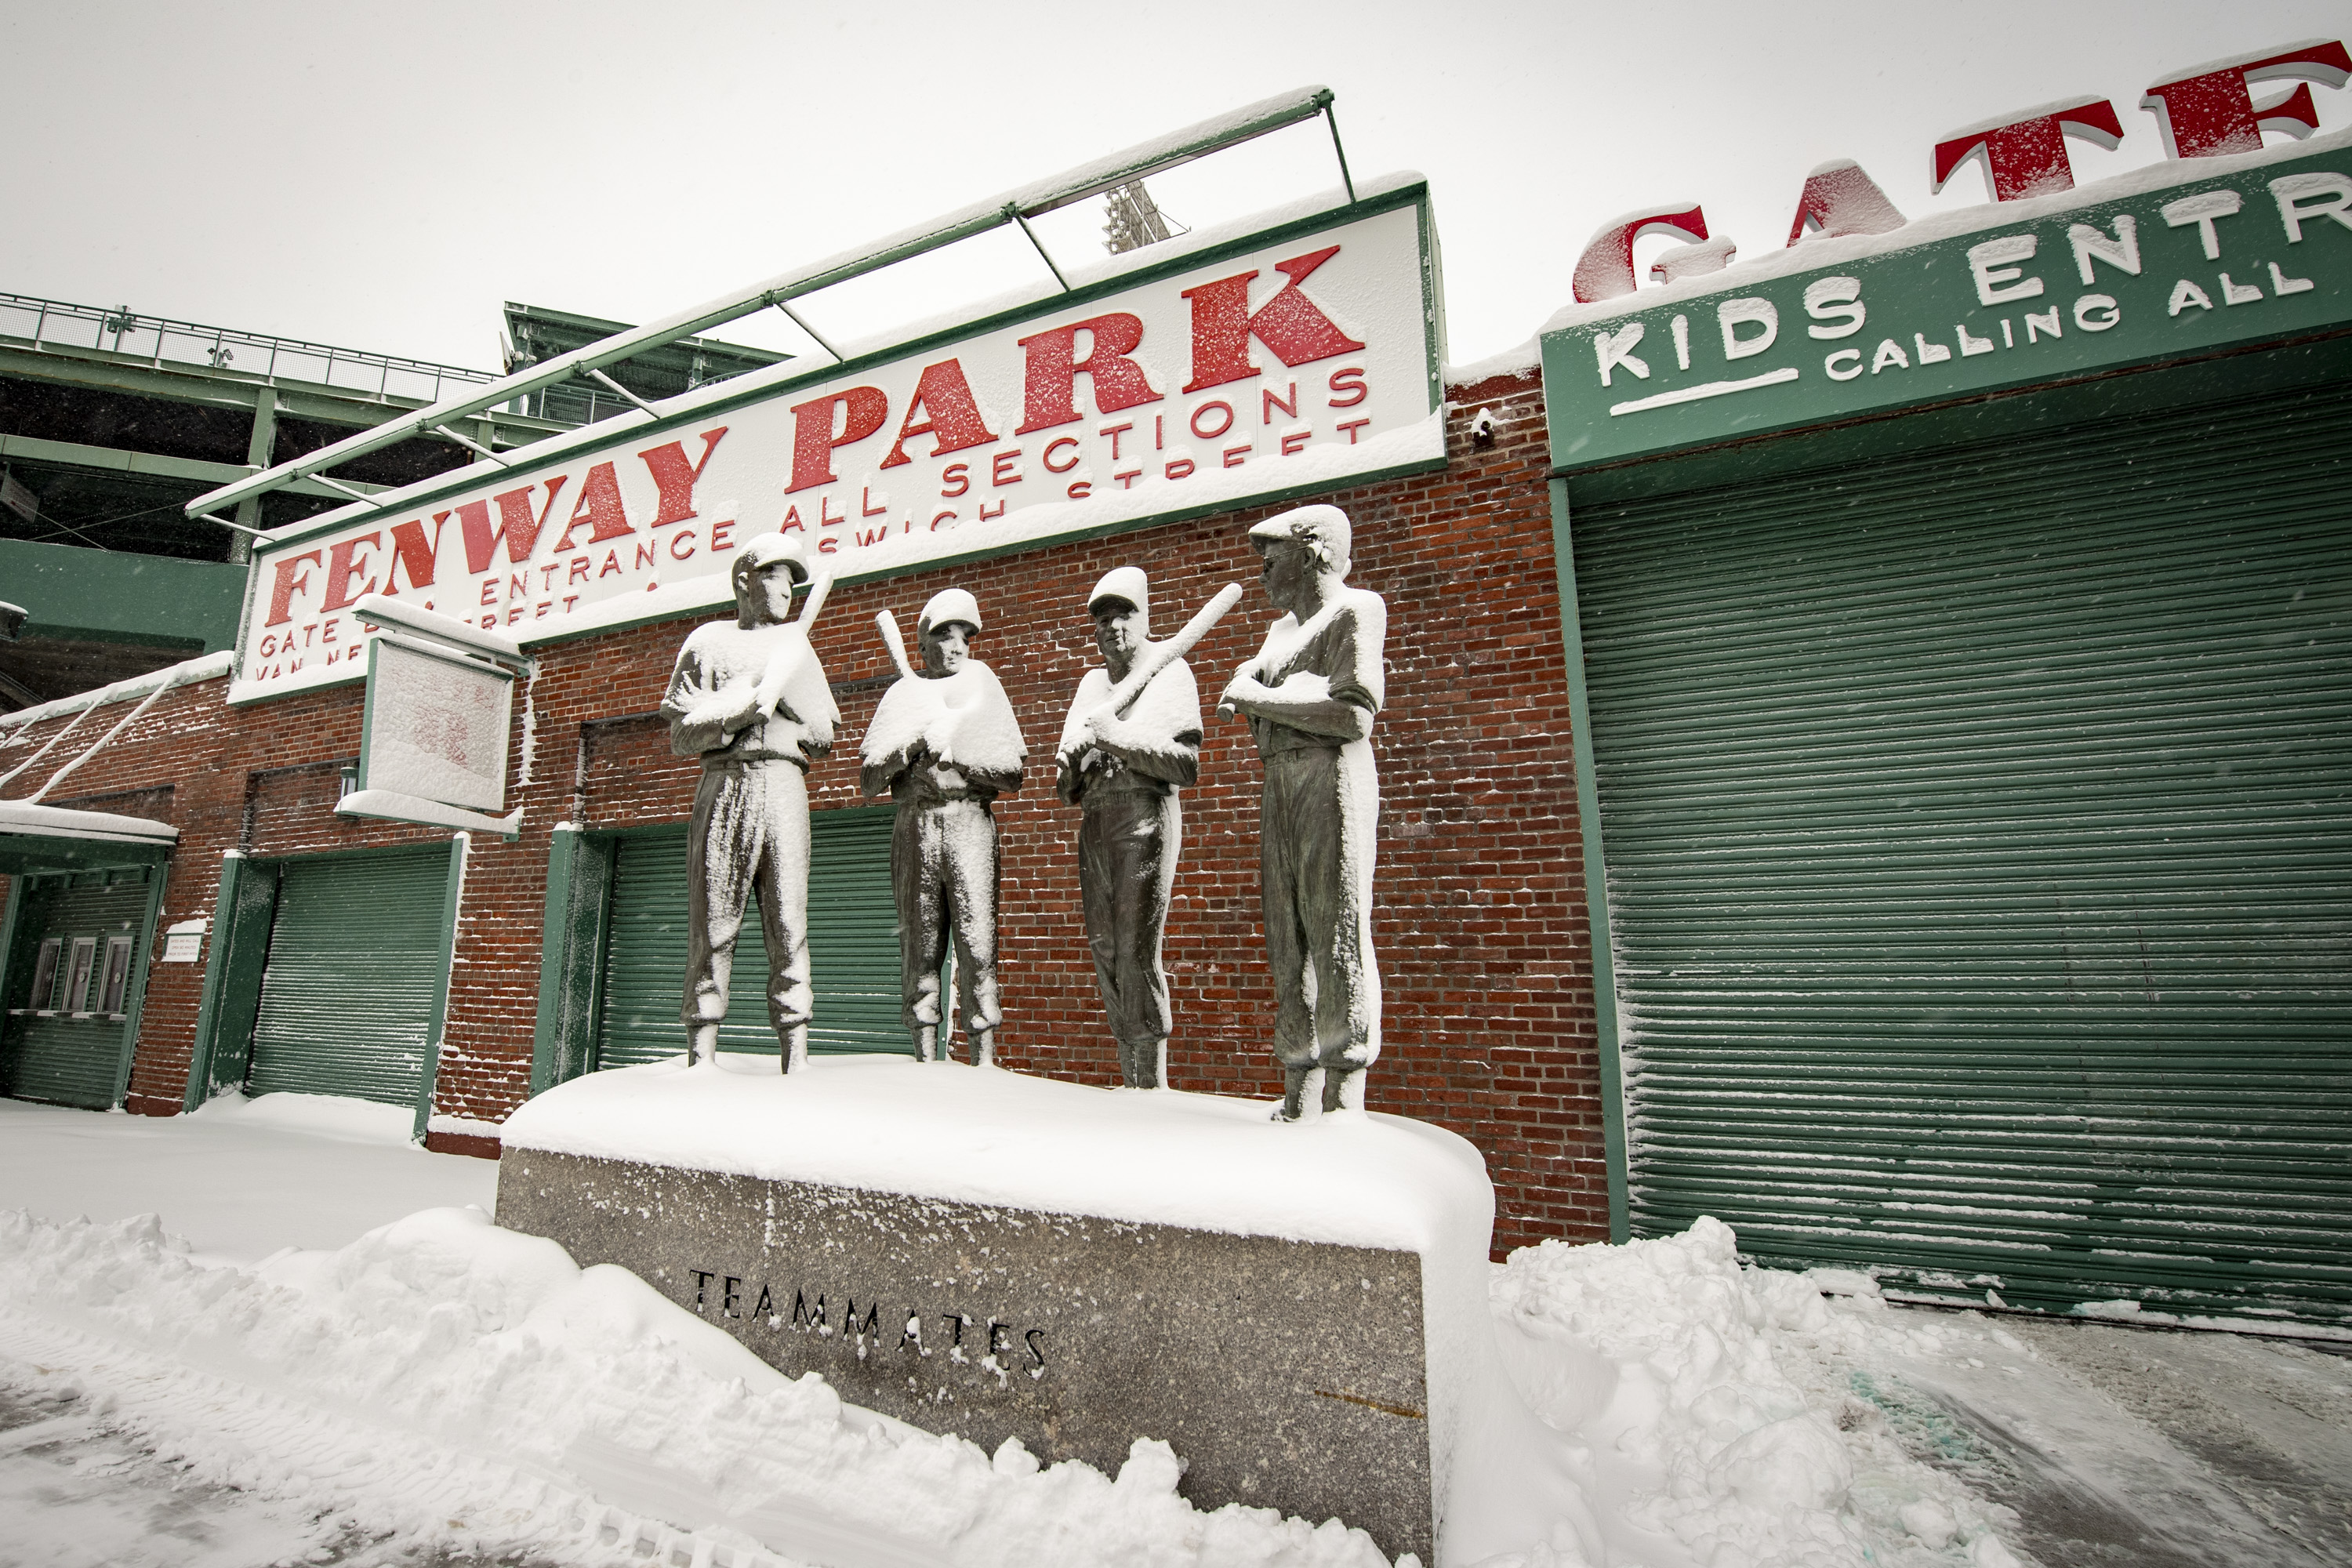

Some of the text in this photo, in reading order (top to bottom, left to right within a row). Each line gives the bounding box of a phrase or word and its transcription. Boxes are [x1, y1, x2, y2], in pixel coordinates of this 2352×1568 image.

[1594, 277, 1867, 387] KIDS
[1824, 262, 2314, 382] CALLING ALL
[265, 245, 1366, 626] FENWAY PARK
[260, 368, 1368, 659] GATE ENTRANCE ALL SECTIONS
[256, 657, 303, 681] VAN
[463, 594, 579, 631] REET
[688, 1269, 1046, 1378] TEAMMATES
